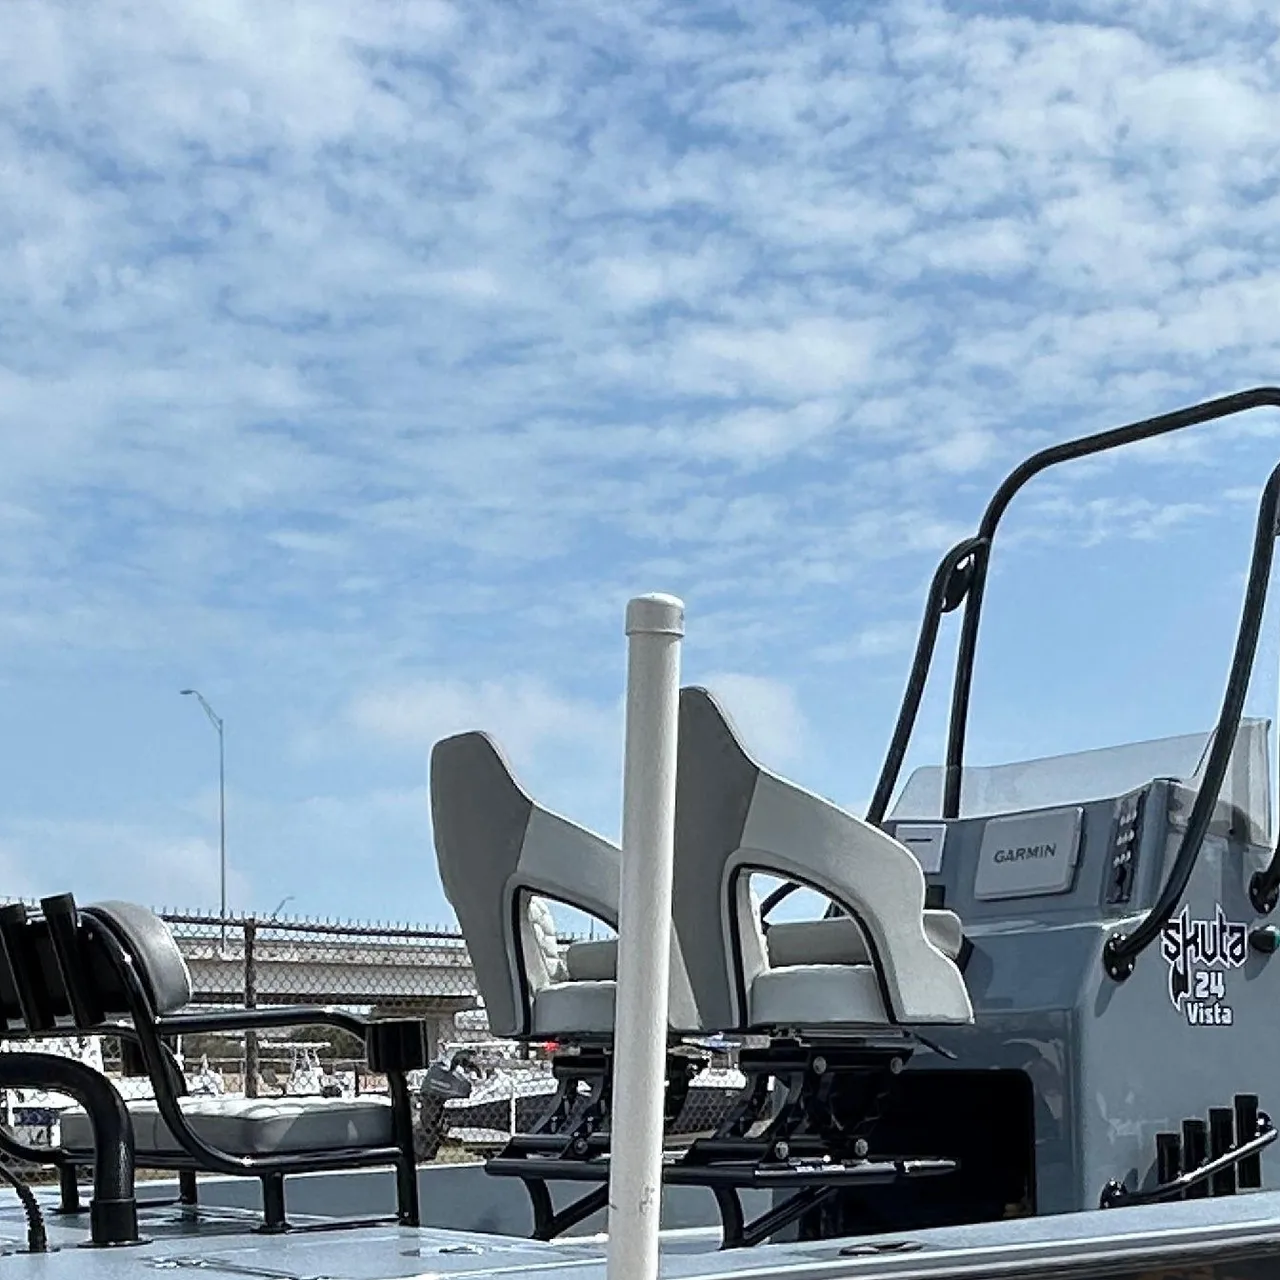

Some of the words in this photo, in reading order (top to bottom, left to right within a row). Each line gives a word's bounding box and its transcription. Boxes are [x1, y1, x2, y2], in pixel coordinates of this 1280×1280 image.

[994, 843, 1057, 863] GARMIN
[1195, 971, 1225, 998] 24
[1187, 1002, 1233, 1025] Vista
